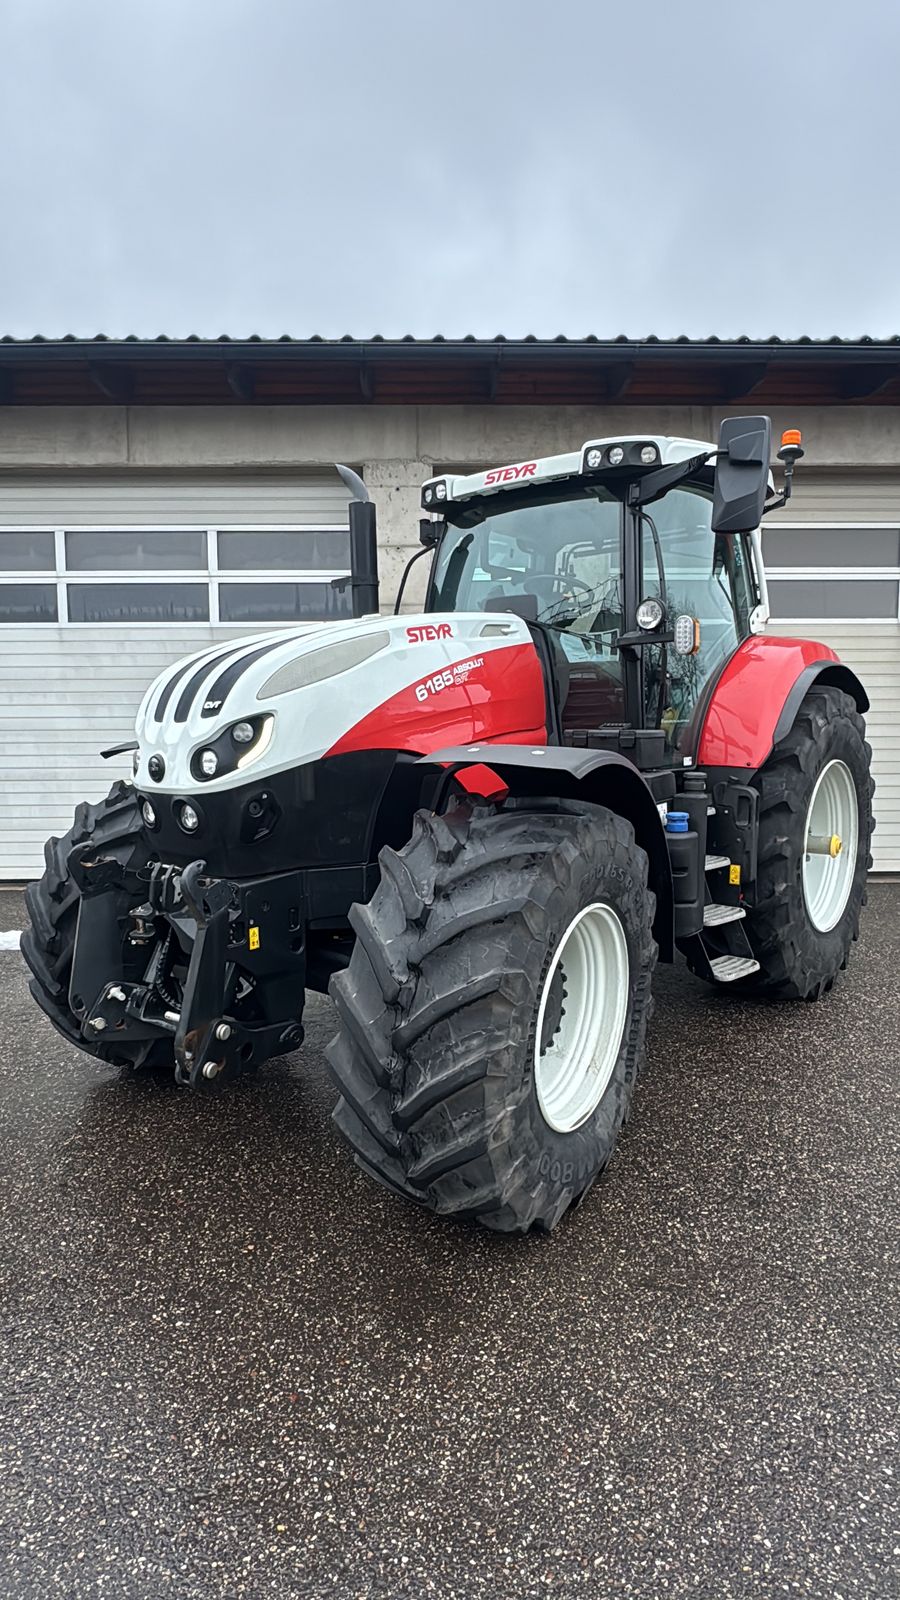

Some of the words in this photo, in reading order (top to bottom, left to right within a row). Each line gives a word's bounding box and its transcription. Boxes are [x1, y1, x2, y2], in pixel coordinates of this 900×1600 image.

[484, 463, 537, 486] STEYR
[406, 623, 455, 644] STEYR
[415, 669, 454, 702] 6185
[453, 658, 485, 676] ABSOLUT
[203, 700, 223, 710] CVT
